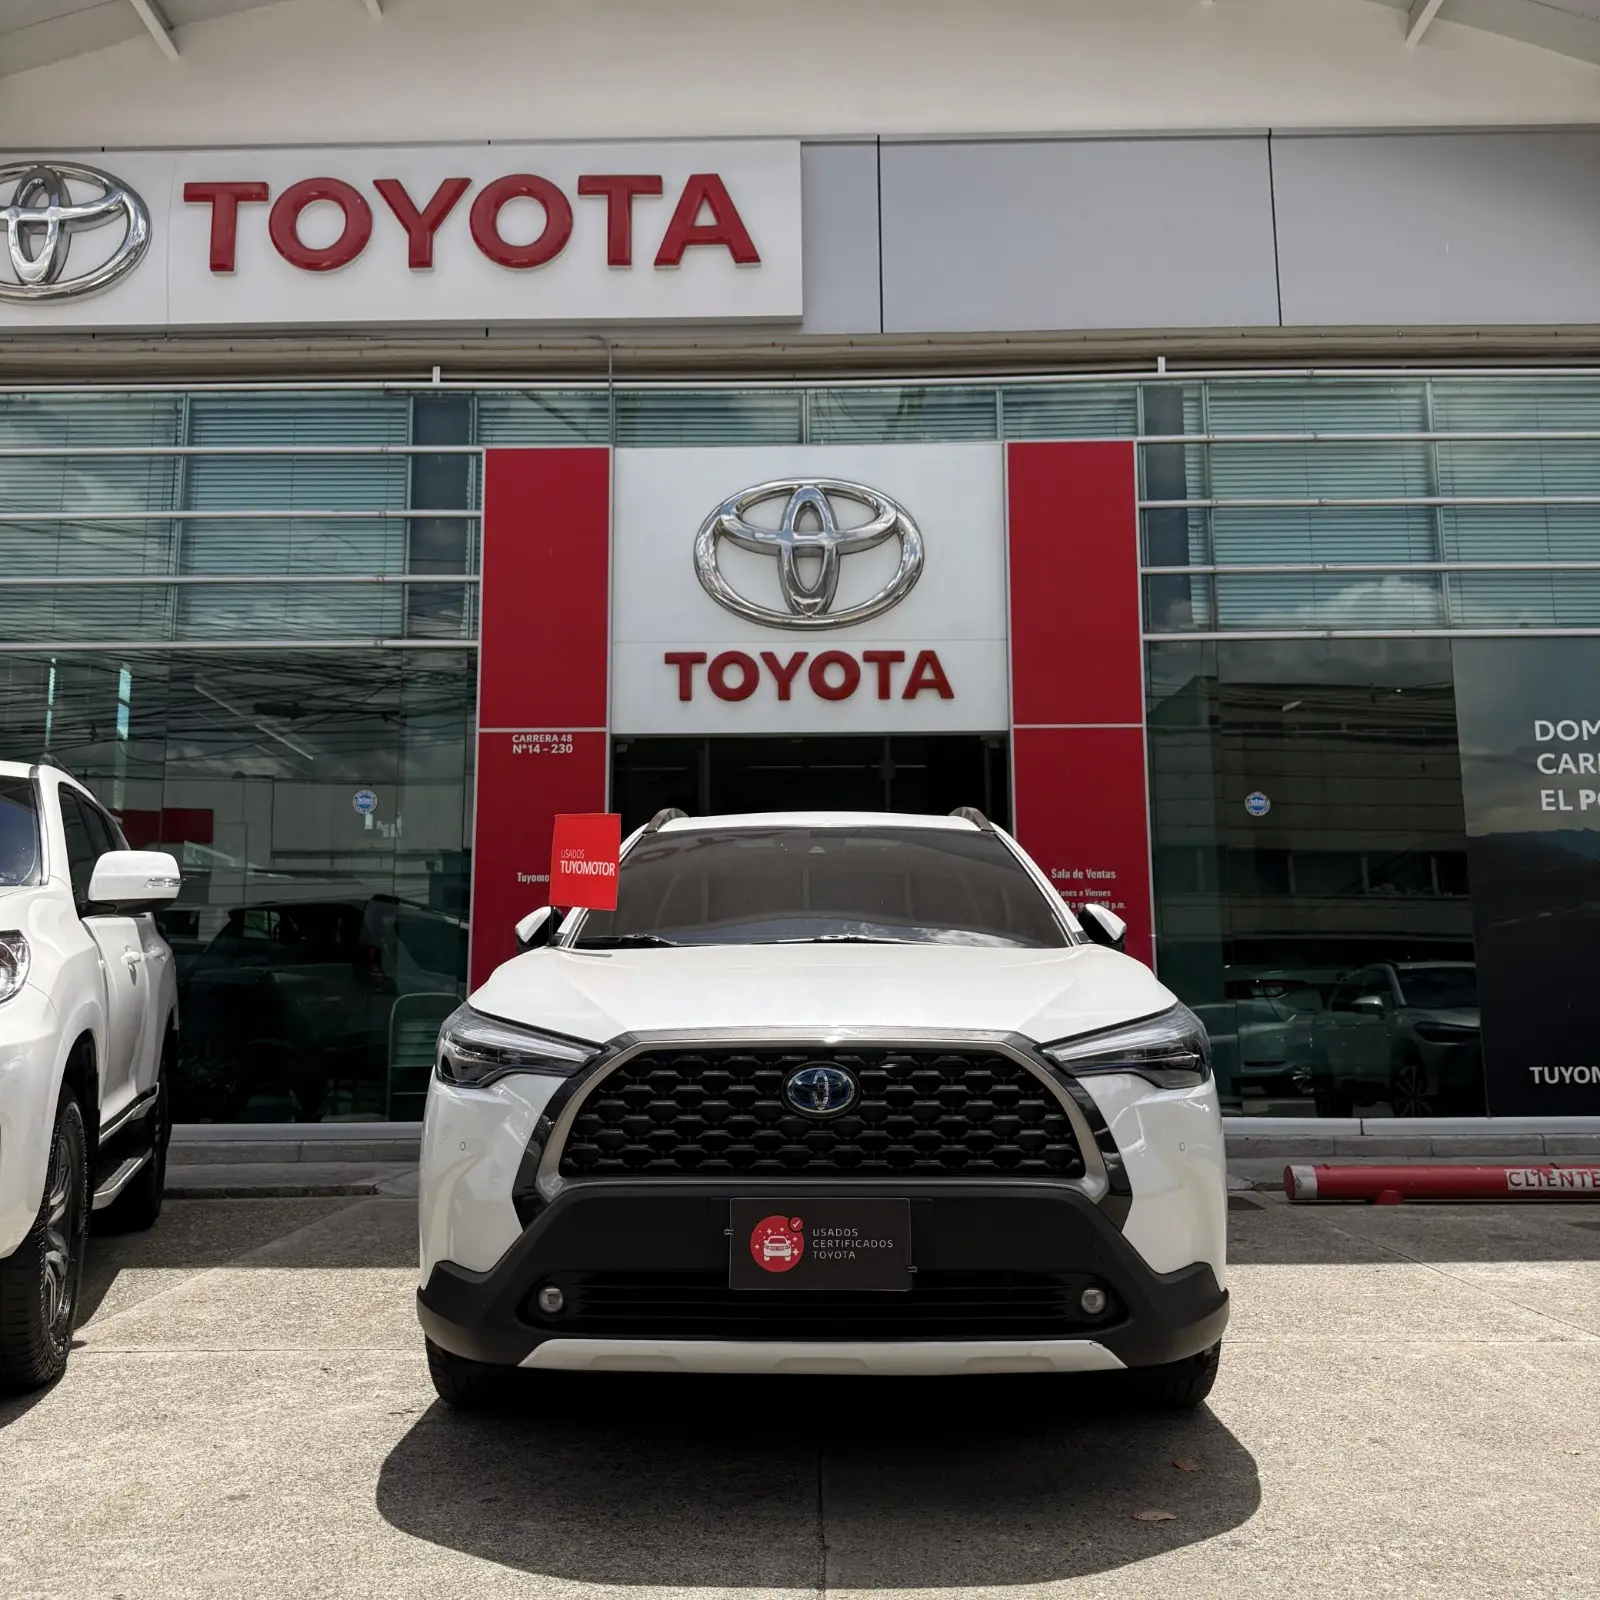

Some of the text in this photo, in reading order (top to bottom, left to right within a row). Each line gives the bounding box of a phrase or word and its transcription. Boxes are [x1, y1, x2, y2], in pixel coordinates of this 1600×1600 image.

[183, 173, 761, 274] TOYOTA
[664, 650, 955, 702] TOYOTA
[512, 734, 573, 743] CARRERA 48
[551, 744, 573, 753] 230
[1537, 753, 1600, 775] CAR
[1541, 789, 1600, 811] EL P
[561, 849, 585, 859] USADOS
[560, 861, 615, 876] TUYOMOTOR
[1051, 868, 1116, 878] Sala de Ventas
[516, 872, 550, 884] Tuyomo
[812, 1228, 858, 1237] USADOS
[812, 1239, 894, 1248] CERTIFICADOS
[812, 1250, 856, 1260] TOYOTA
